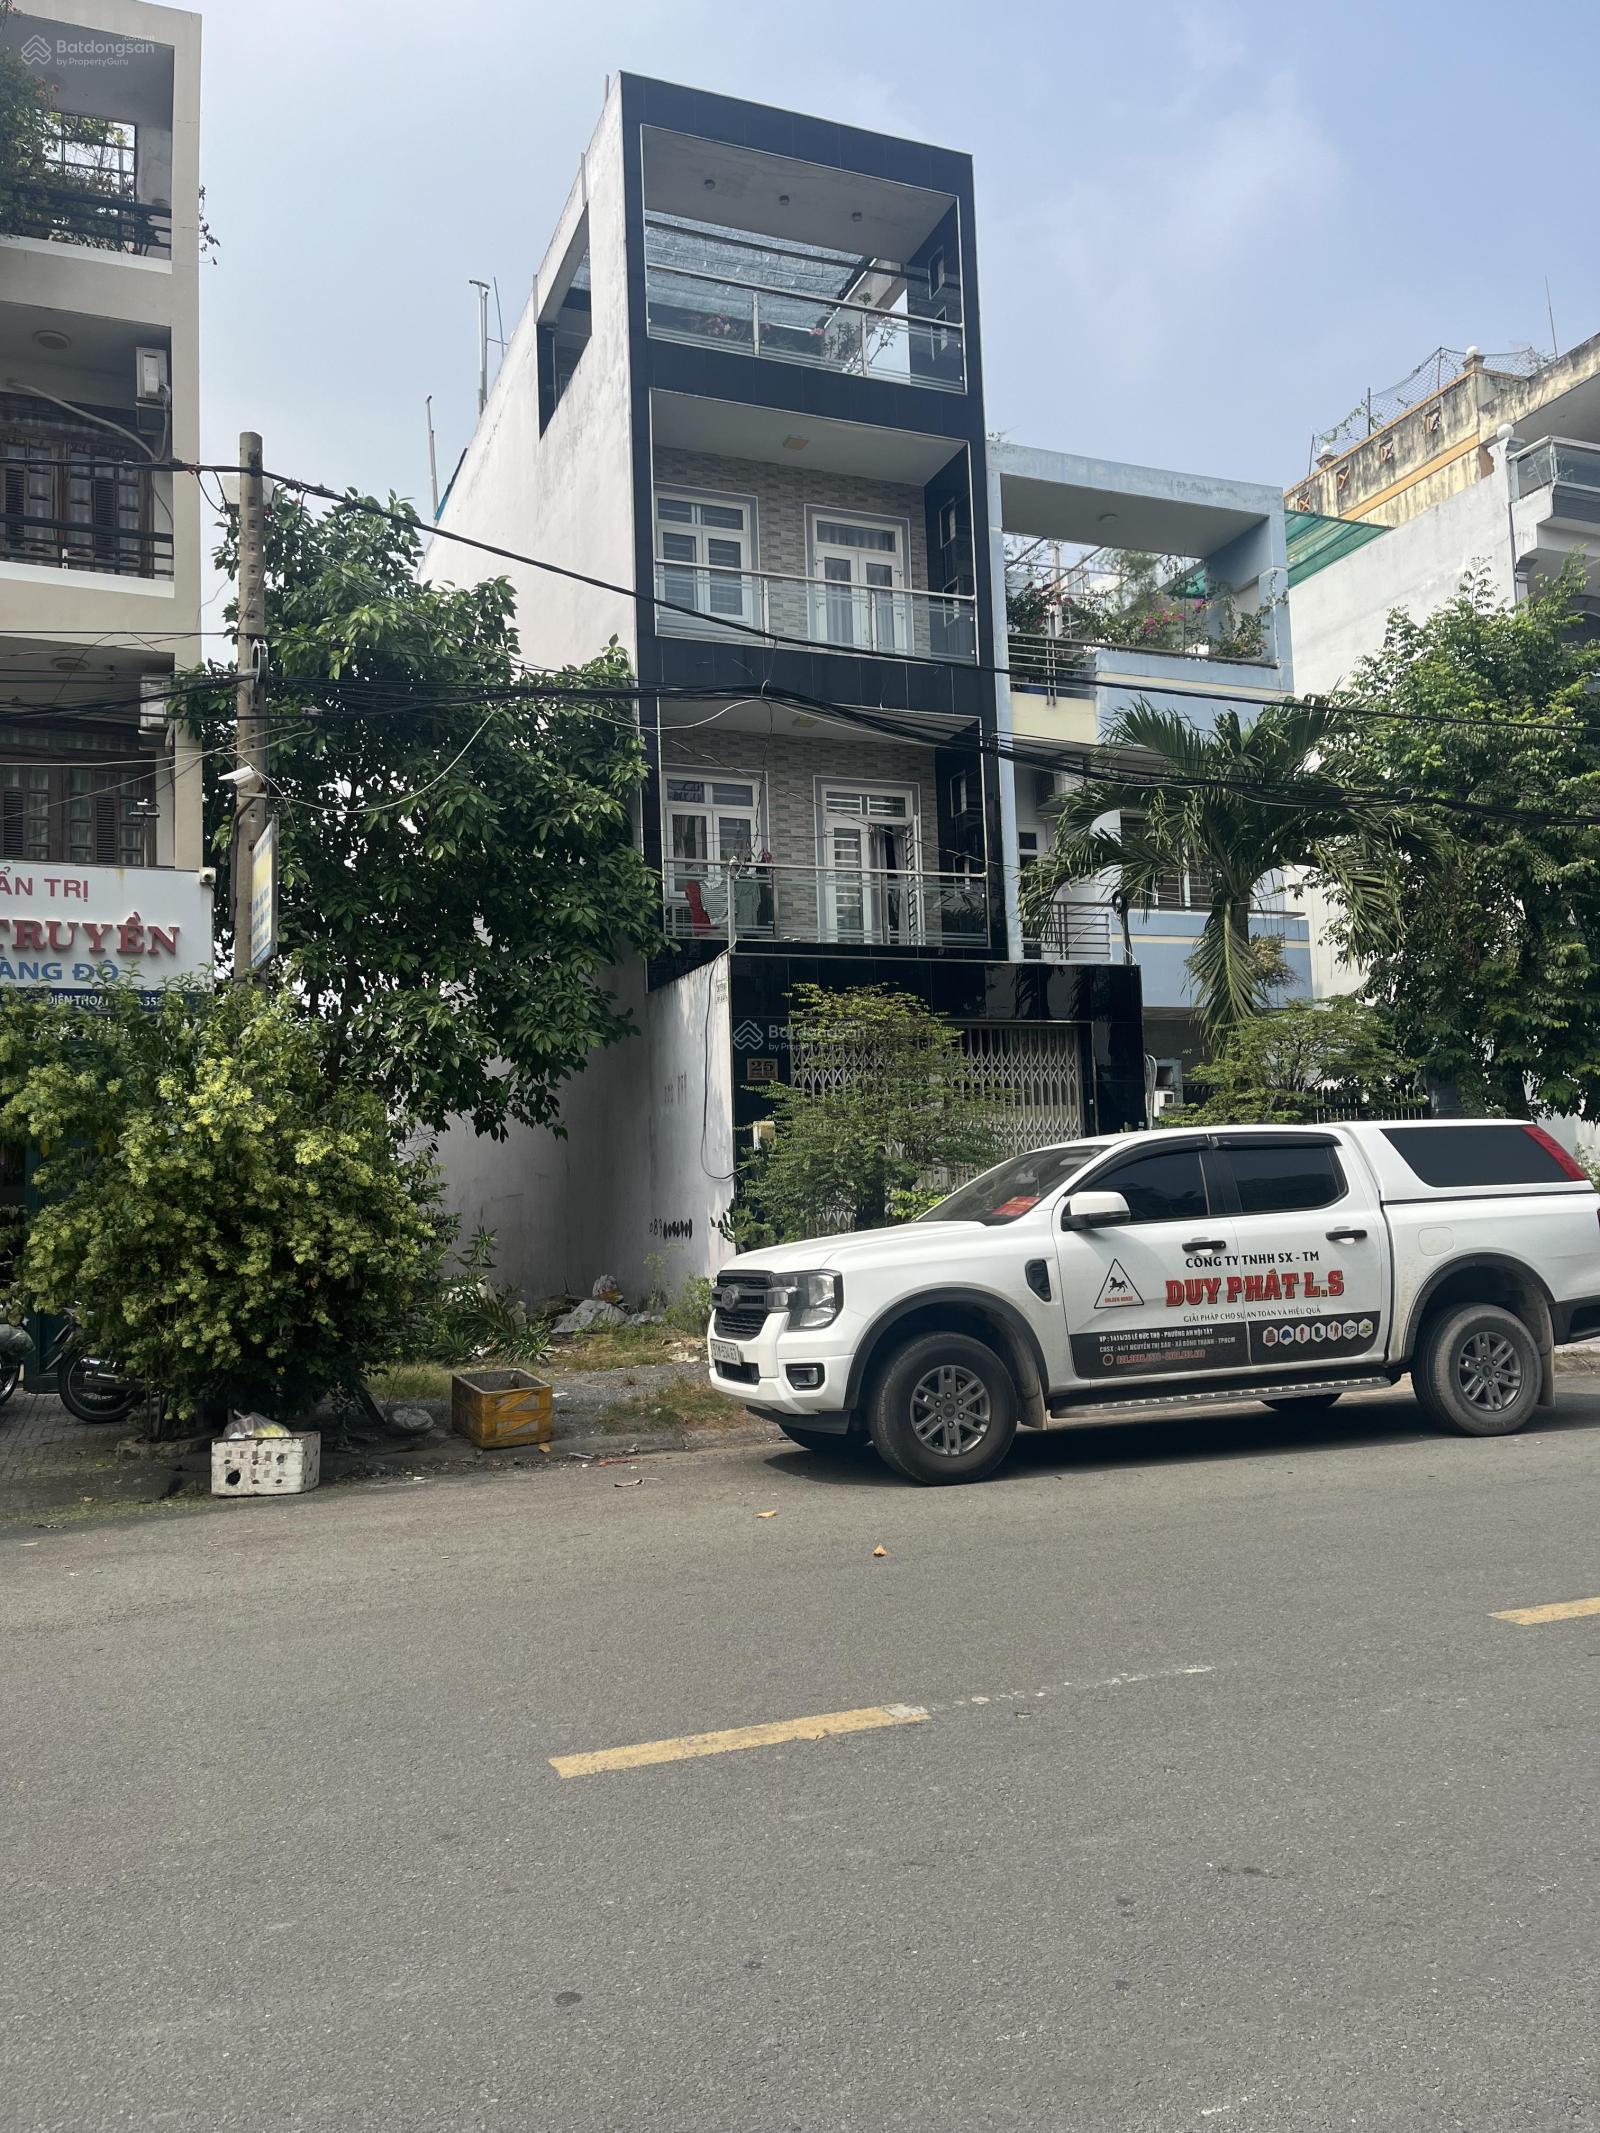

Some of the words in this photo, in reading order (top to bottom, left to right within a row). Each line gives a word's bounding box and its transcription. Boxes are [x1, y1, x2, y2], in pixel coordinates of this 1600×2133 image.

[43, 878, 89, 902] TRỊ
[72, 959, 119, 981] ĐÔ
[751, 1060, 774, 1072] 25
[1185, 1255, 1221, 1268] CÔNG
[1224, 1255, 1239, 1266] TY
[1241, 1253, 1275, 1265] TNHH
[1278, 1252, 1293, 1263] SX
[1302, 1251, 1319, 1261] TM
[1165, 1277, 1222, 1307] DUY
[1226, 1268, 1300, 1303] PHÁT
[1303, 1270, 1345, 1298] L.S
[1220, 1312, 1236, 1320] CHO
